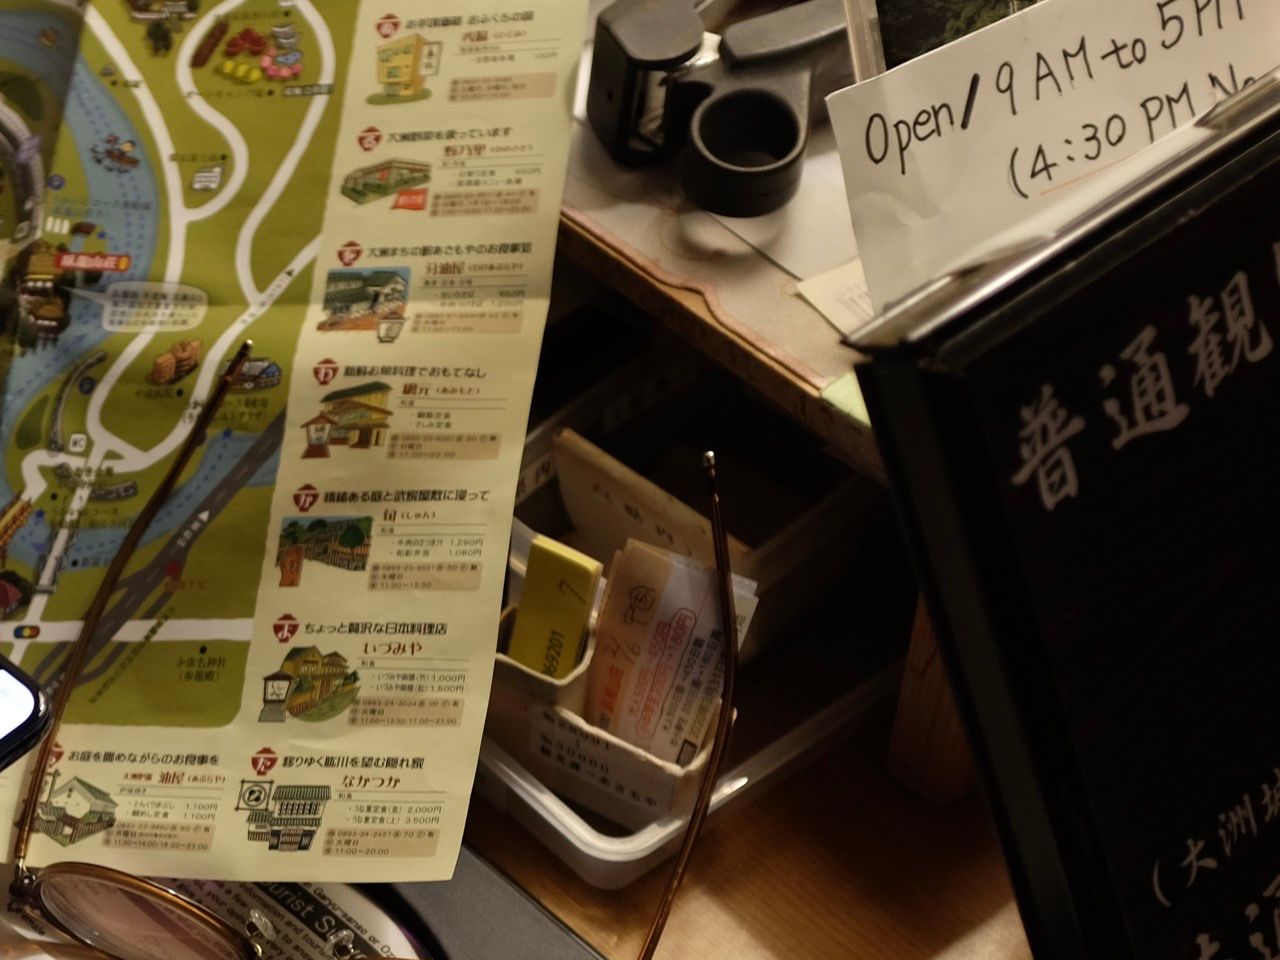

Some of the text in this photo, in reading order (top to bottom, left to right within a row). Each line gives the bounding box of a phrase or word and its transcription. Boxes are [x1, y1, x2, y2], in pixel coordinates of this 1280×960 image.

[995, 62, 1018, 116] 9
[1034, 36, 1094, 101] AM
[1100, 38, 1147, 71] to
[1009, 114, 1127, 199] (4:30
[1141, 84, 1197, 145] PM
[1011, 243, 1280, 512] 普通観
[363, 641, 424, 656] いづみや
[341, 774, 402, 790] なかつか
